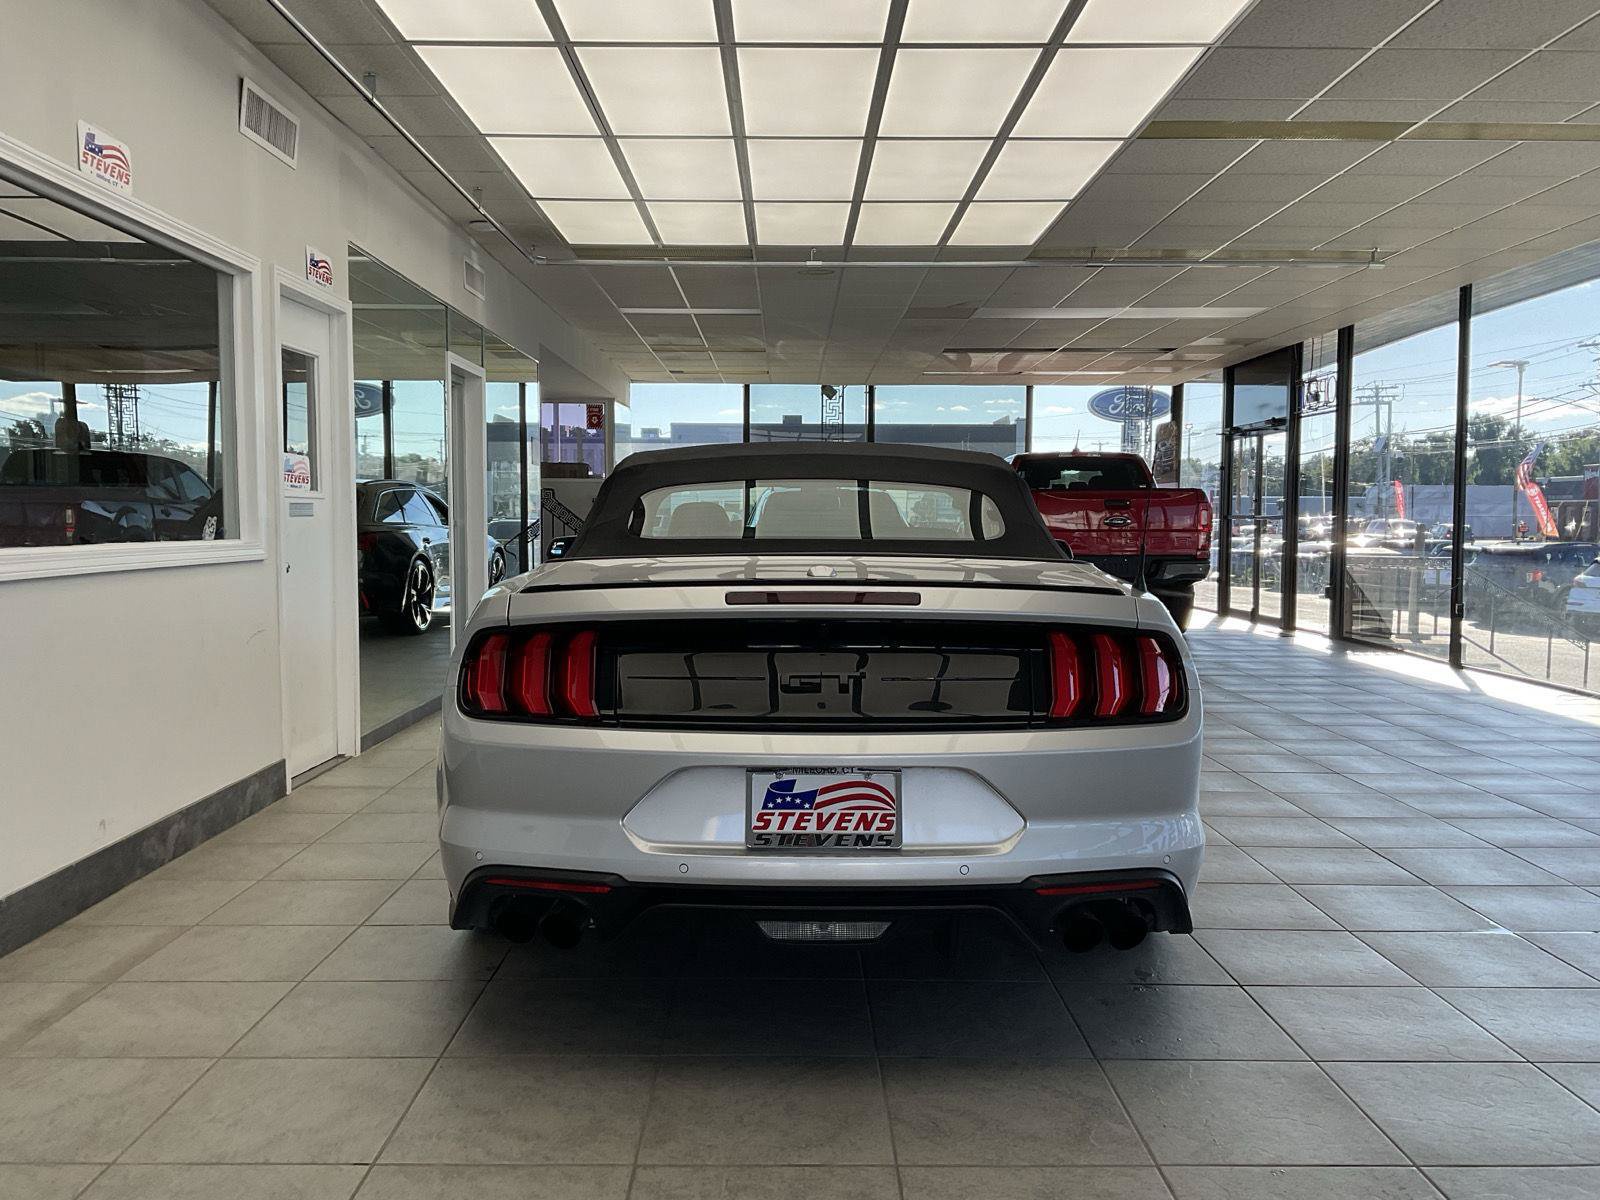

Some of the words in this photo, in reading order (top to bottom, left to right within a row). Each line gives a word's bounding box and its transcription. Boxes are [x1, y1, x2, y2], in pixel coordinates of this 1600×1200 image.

[82, 151, 131, 186] STEVENS
[308, 266, 333, 286] STEVENS
[752, 812, 896, 832] STEVENS
[754, 833, 894, 847] STEVENS
